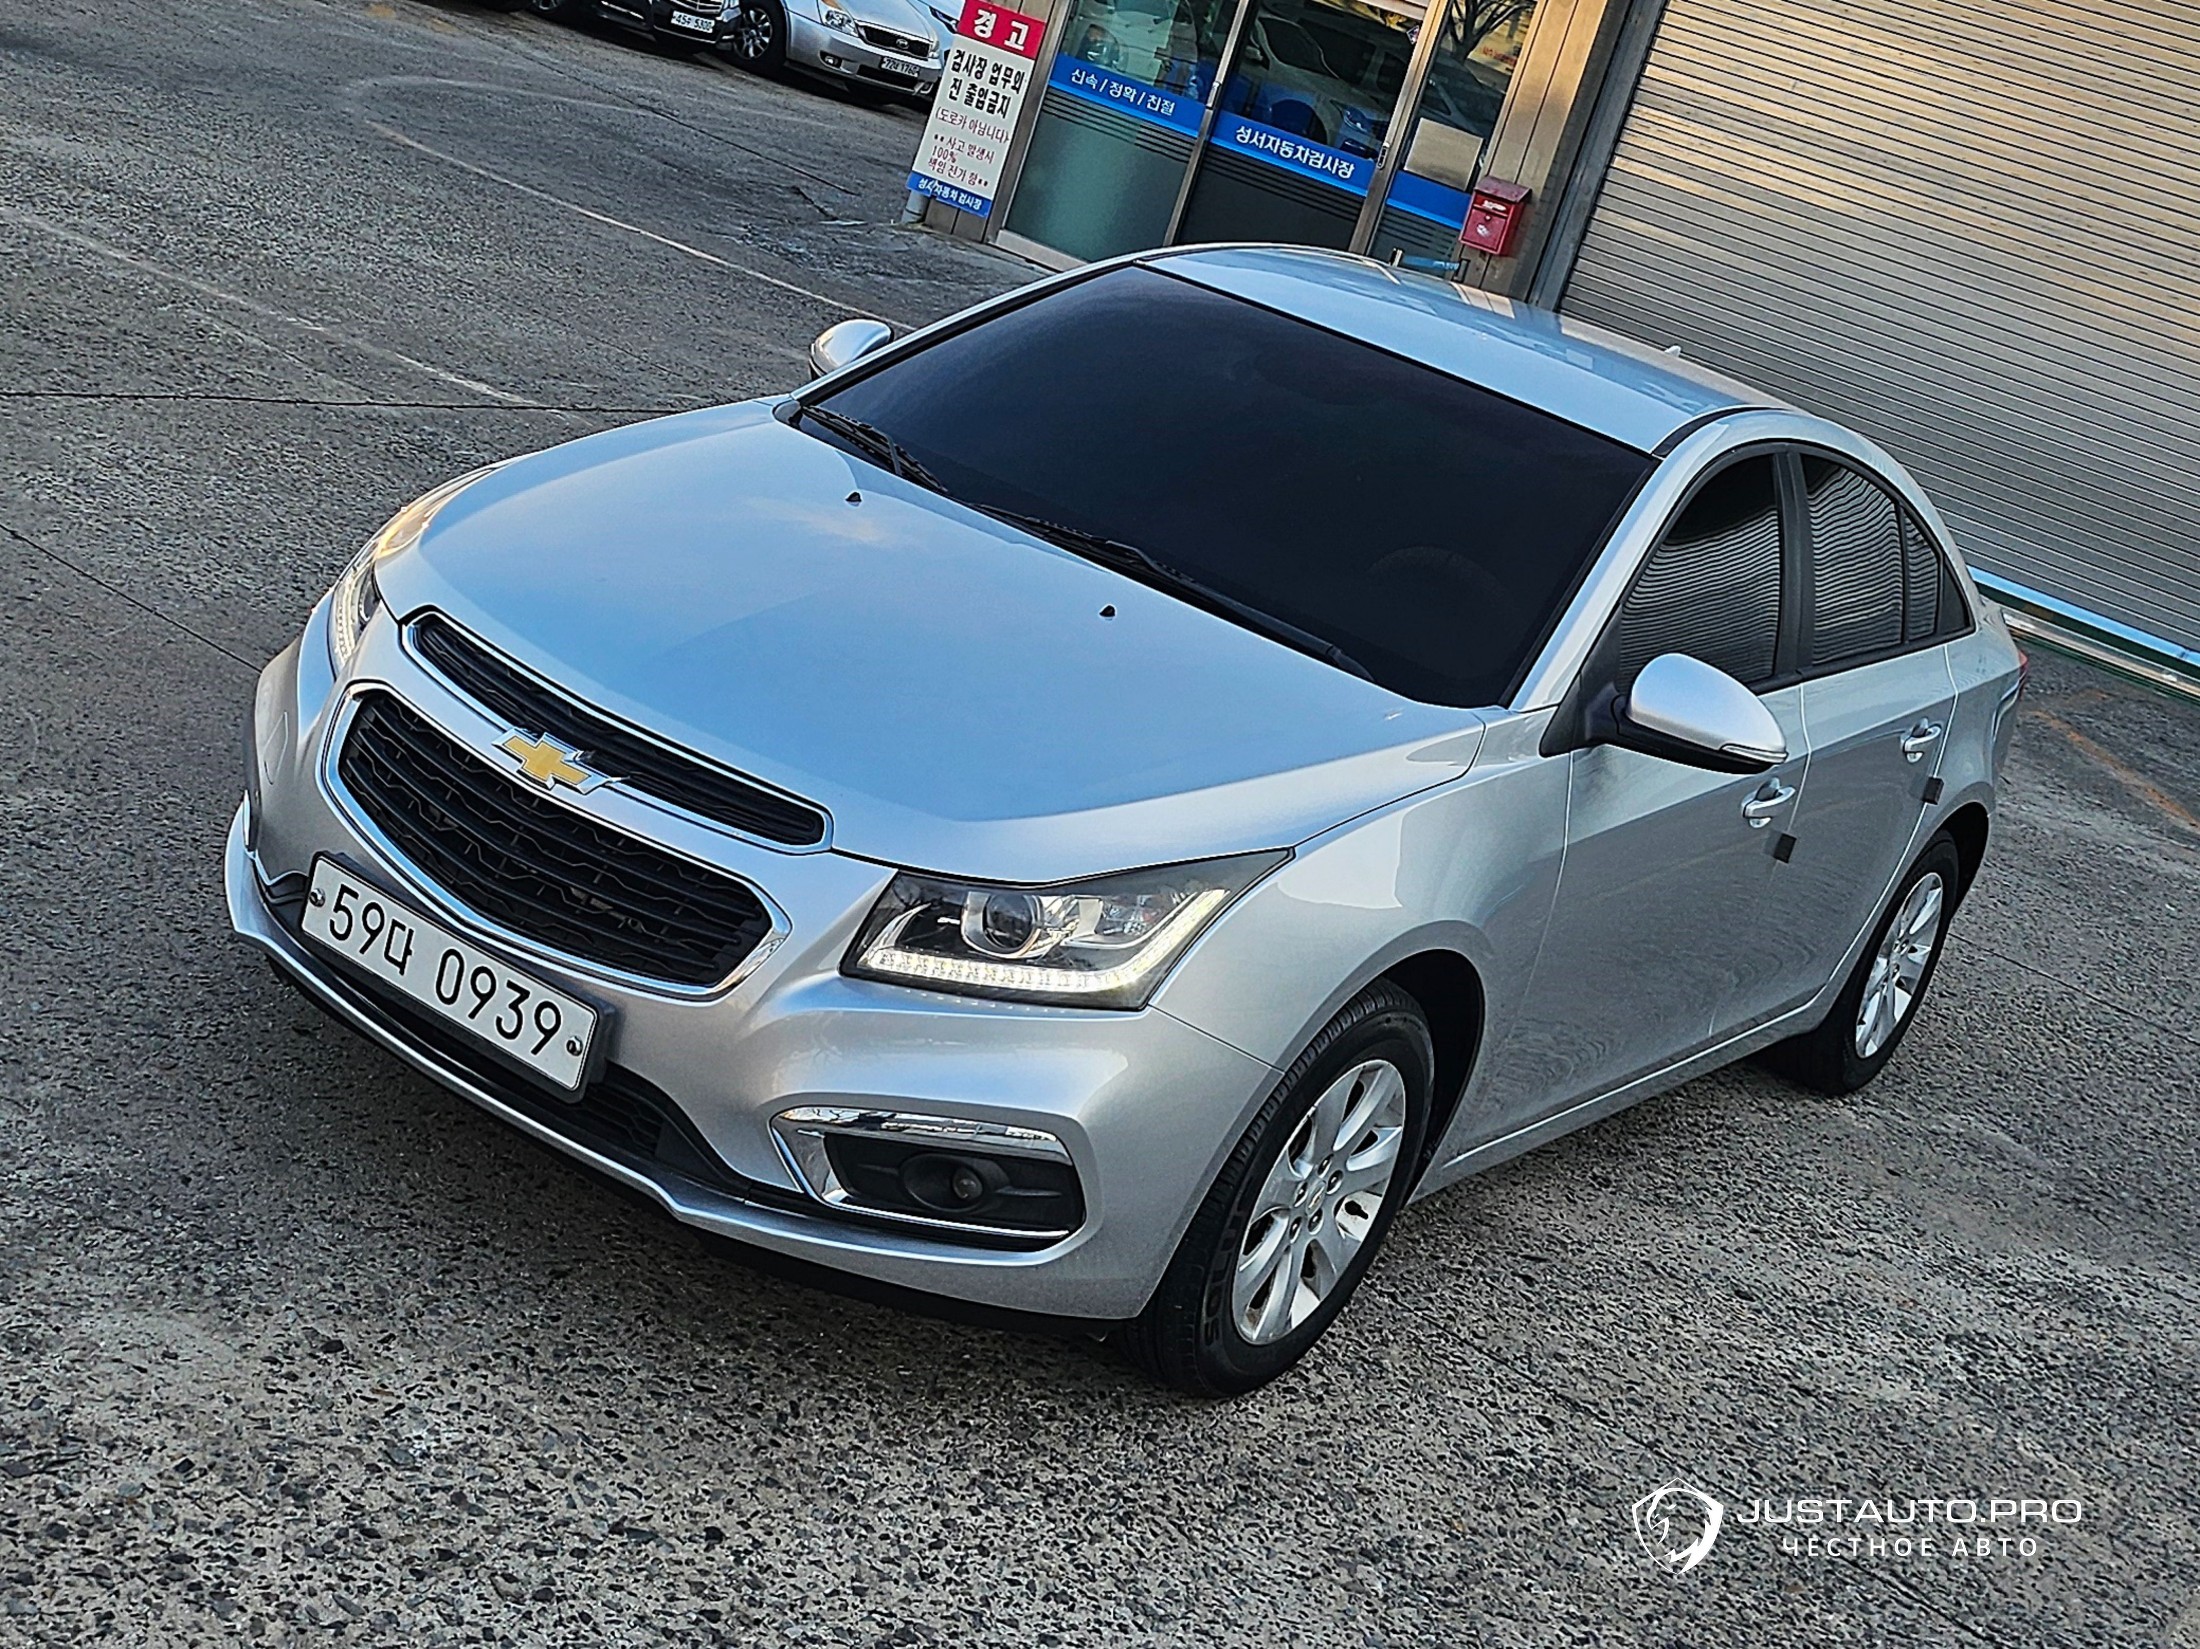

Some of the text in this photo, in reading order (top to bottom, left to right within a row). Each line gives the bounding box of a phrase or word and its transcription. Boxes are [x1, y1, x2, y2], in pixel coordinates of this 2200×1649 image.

[951, 49, 1026, 94] 검사장 업무외
[1071, 69, 1098, 90] 신속
[1109, 81, 1137, 102] 정확
[1147, 94, 1176, 116] 친절
[948, 77, 1011, 119] 진 출입금지
[932, 145, 957, 163] 100%
[1236, 126, 1355, 179] 성서자동차검사장
[329, 884, 562, 1056] 59다 0939
